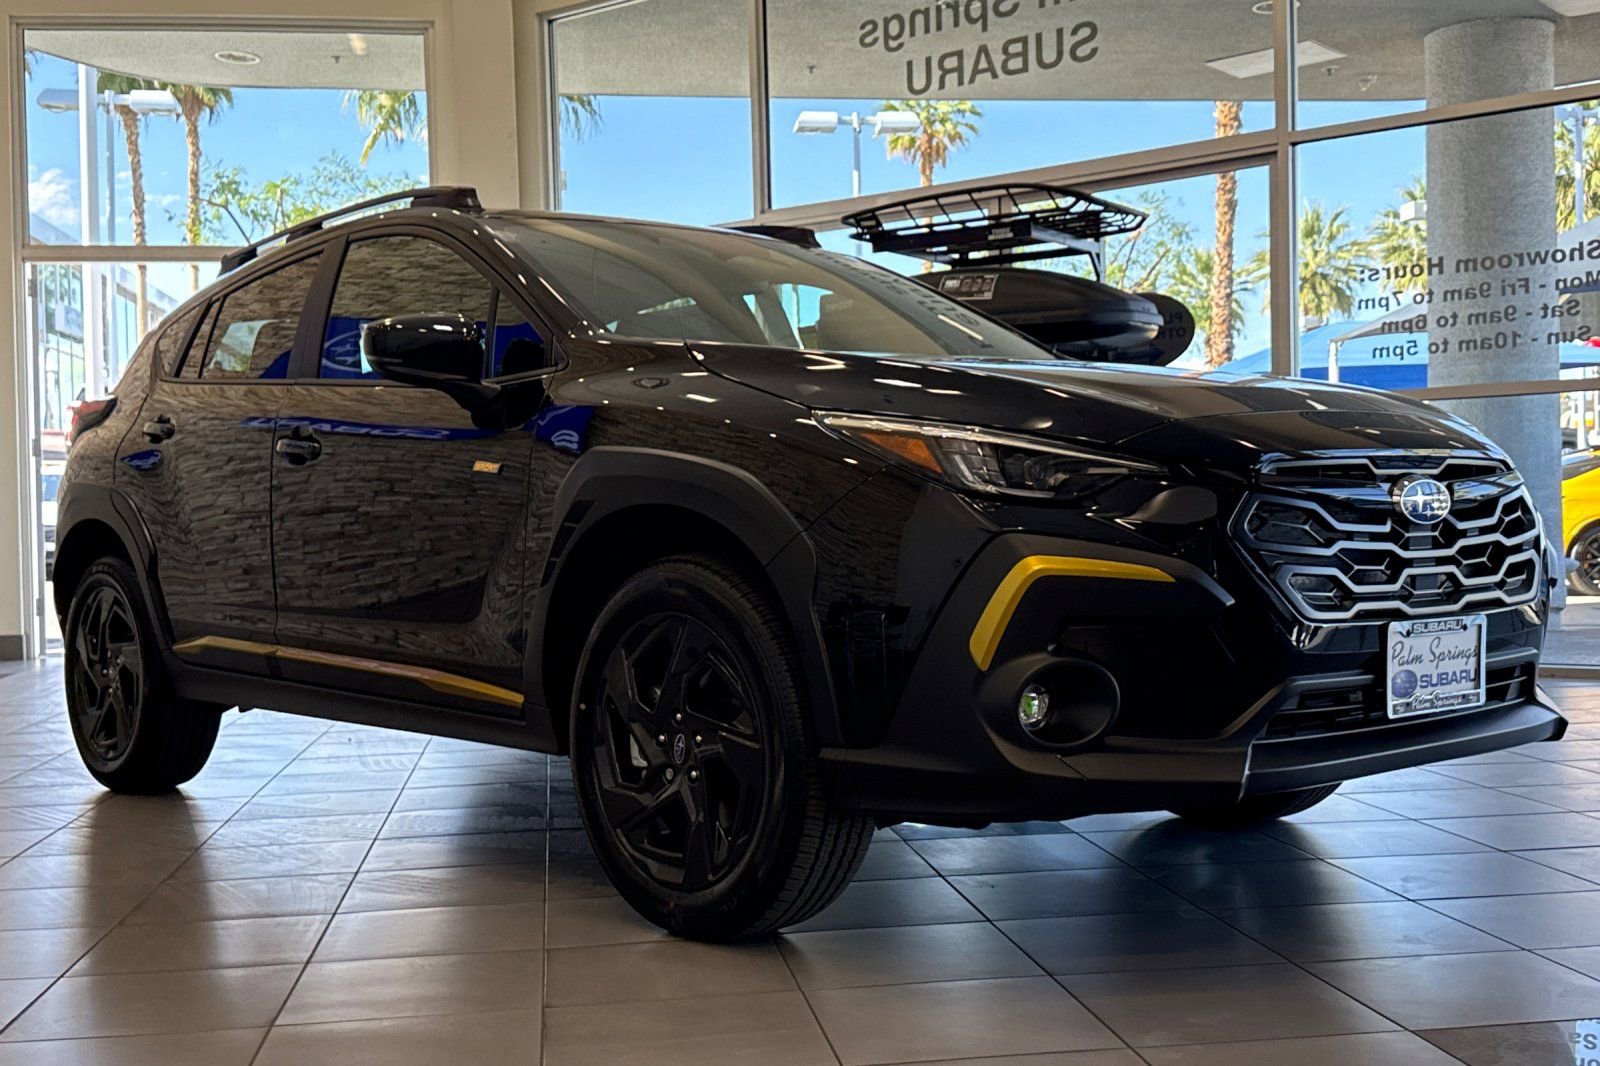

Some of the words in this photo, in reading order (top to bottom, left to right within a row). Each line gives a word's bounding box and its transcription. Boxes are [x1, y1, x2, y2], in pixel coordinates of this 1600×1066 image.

[1412, 619, 1463, 634] SUBARU
[1391, 640, 1424, 667] Palm
[1429, 636, 1478, 670] Springs
[1418, 667, 1478, 689] SUBARU
